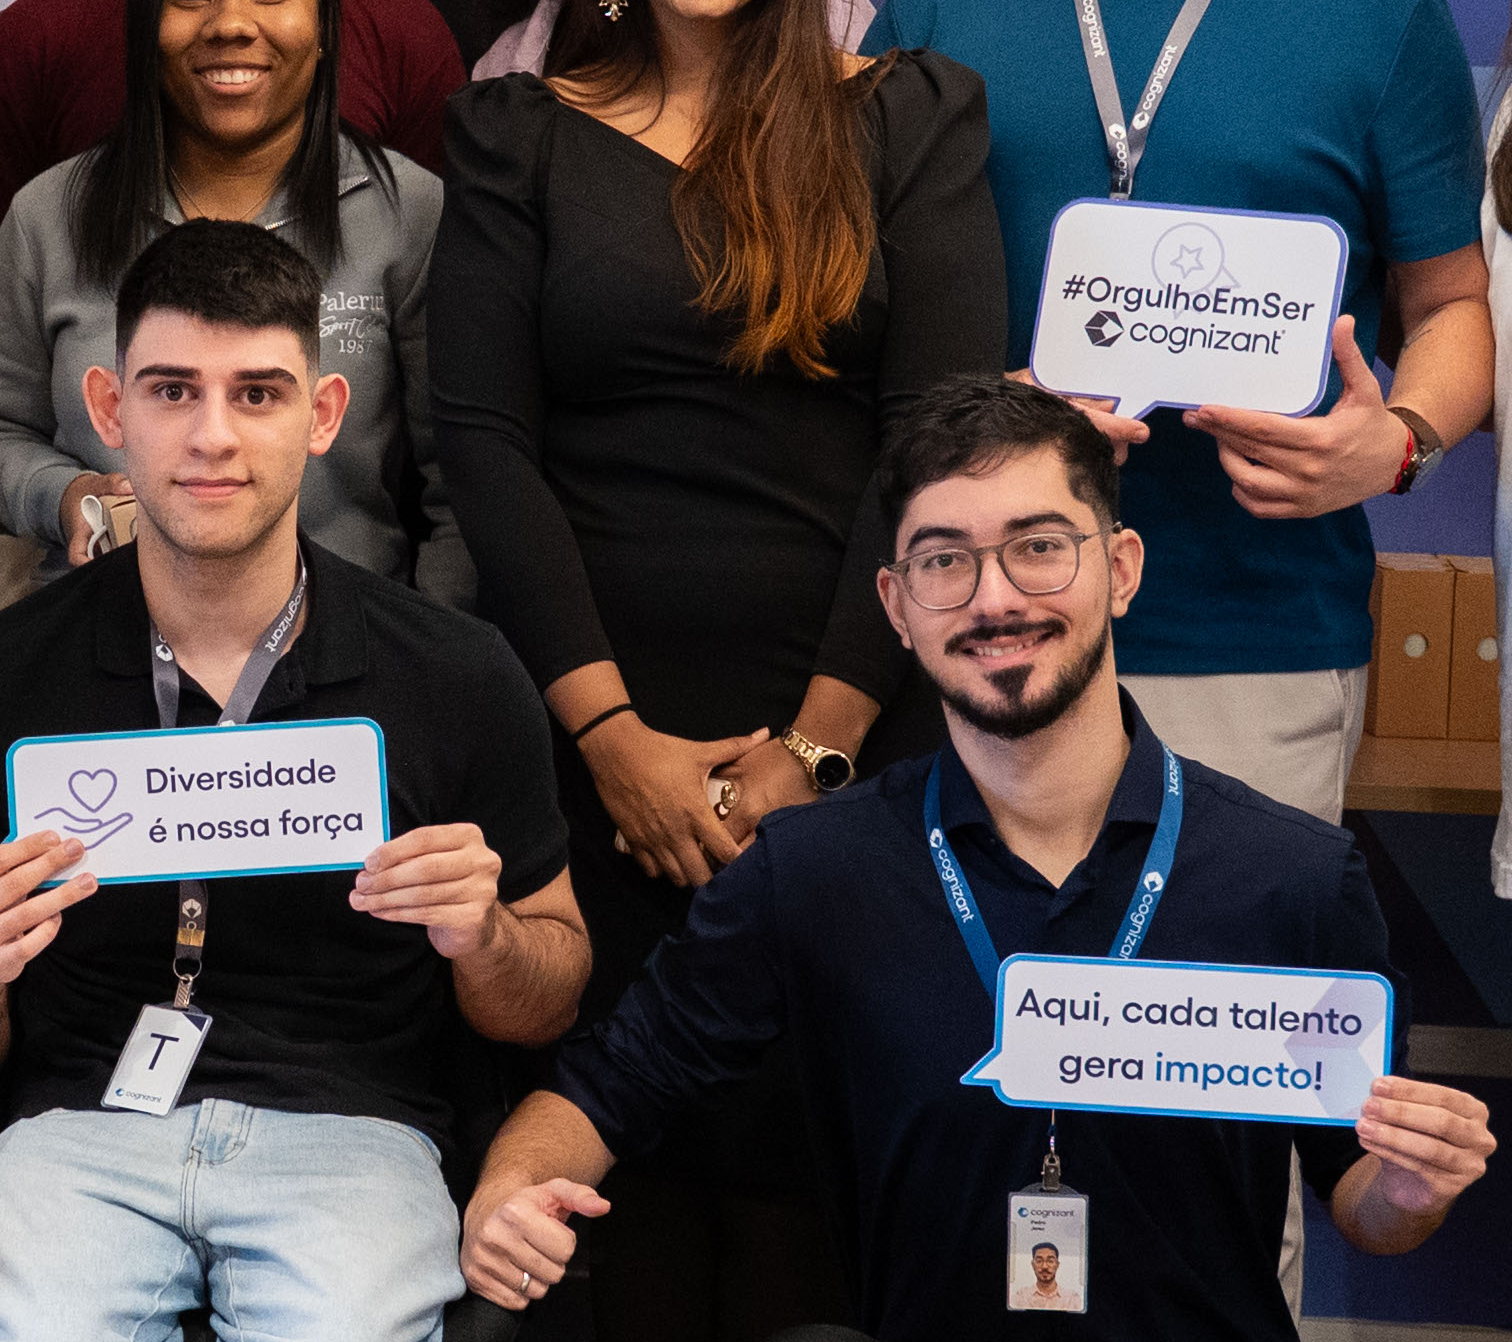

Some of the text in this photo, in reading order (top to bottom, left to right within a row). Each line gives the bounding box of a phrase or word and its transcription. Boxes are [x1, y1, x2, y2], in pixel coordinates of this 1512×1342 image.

[1142, 44, 1178, 111] cognizant
[1062, 274, 1316, 322] #OrgulhoEmSer
[339, 339, 373, 354] 1987
[1129, 323, 1282, 355] cognizant
[264, 586, 305, 653] cognizant
[145, 758, 337, 795] Diversidade
[148, 808, 364, 844] é nossa força
[937, 848, 976, 924] cognizant
[1119, 893, 1155, 960] cogniza
[1015, 987, 1363, 1037] Aqui, cada talento
[149, 1032, 180, 1071] T
[1058, 1050, 1323, 1092] gera impacto!
[1030, 1209, 1075, 1219] cognizant
